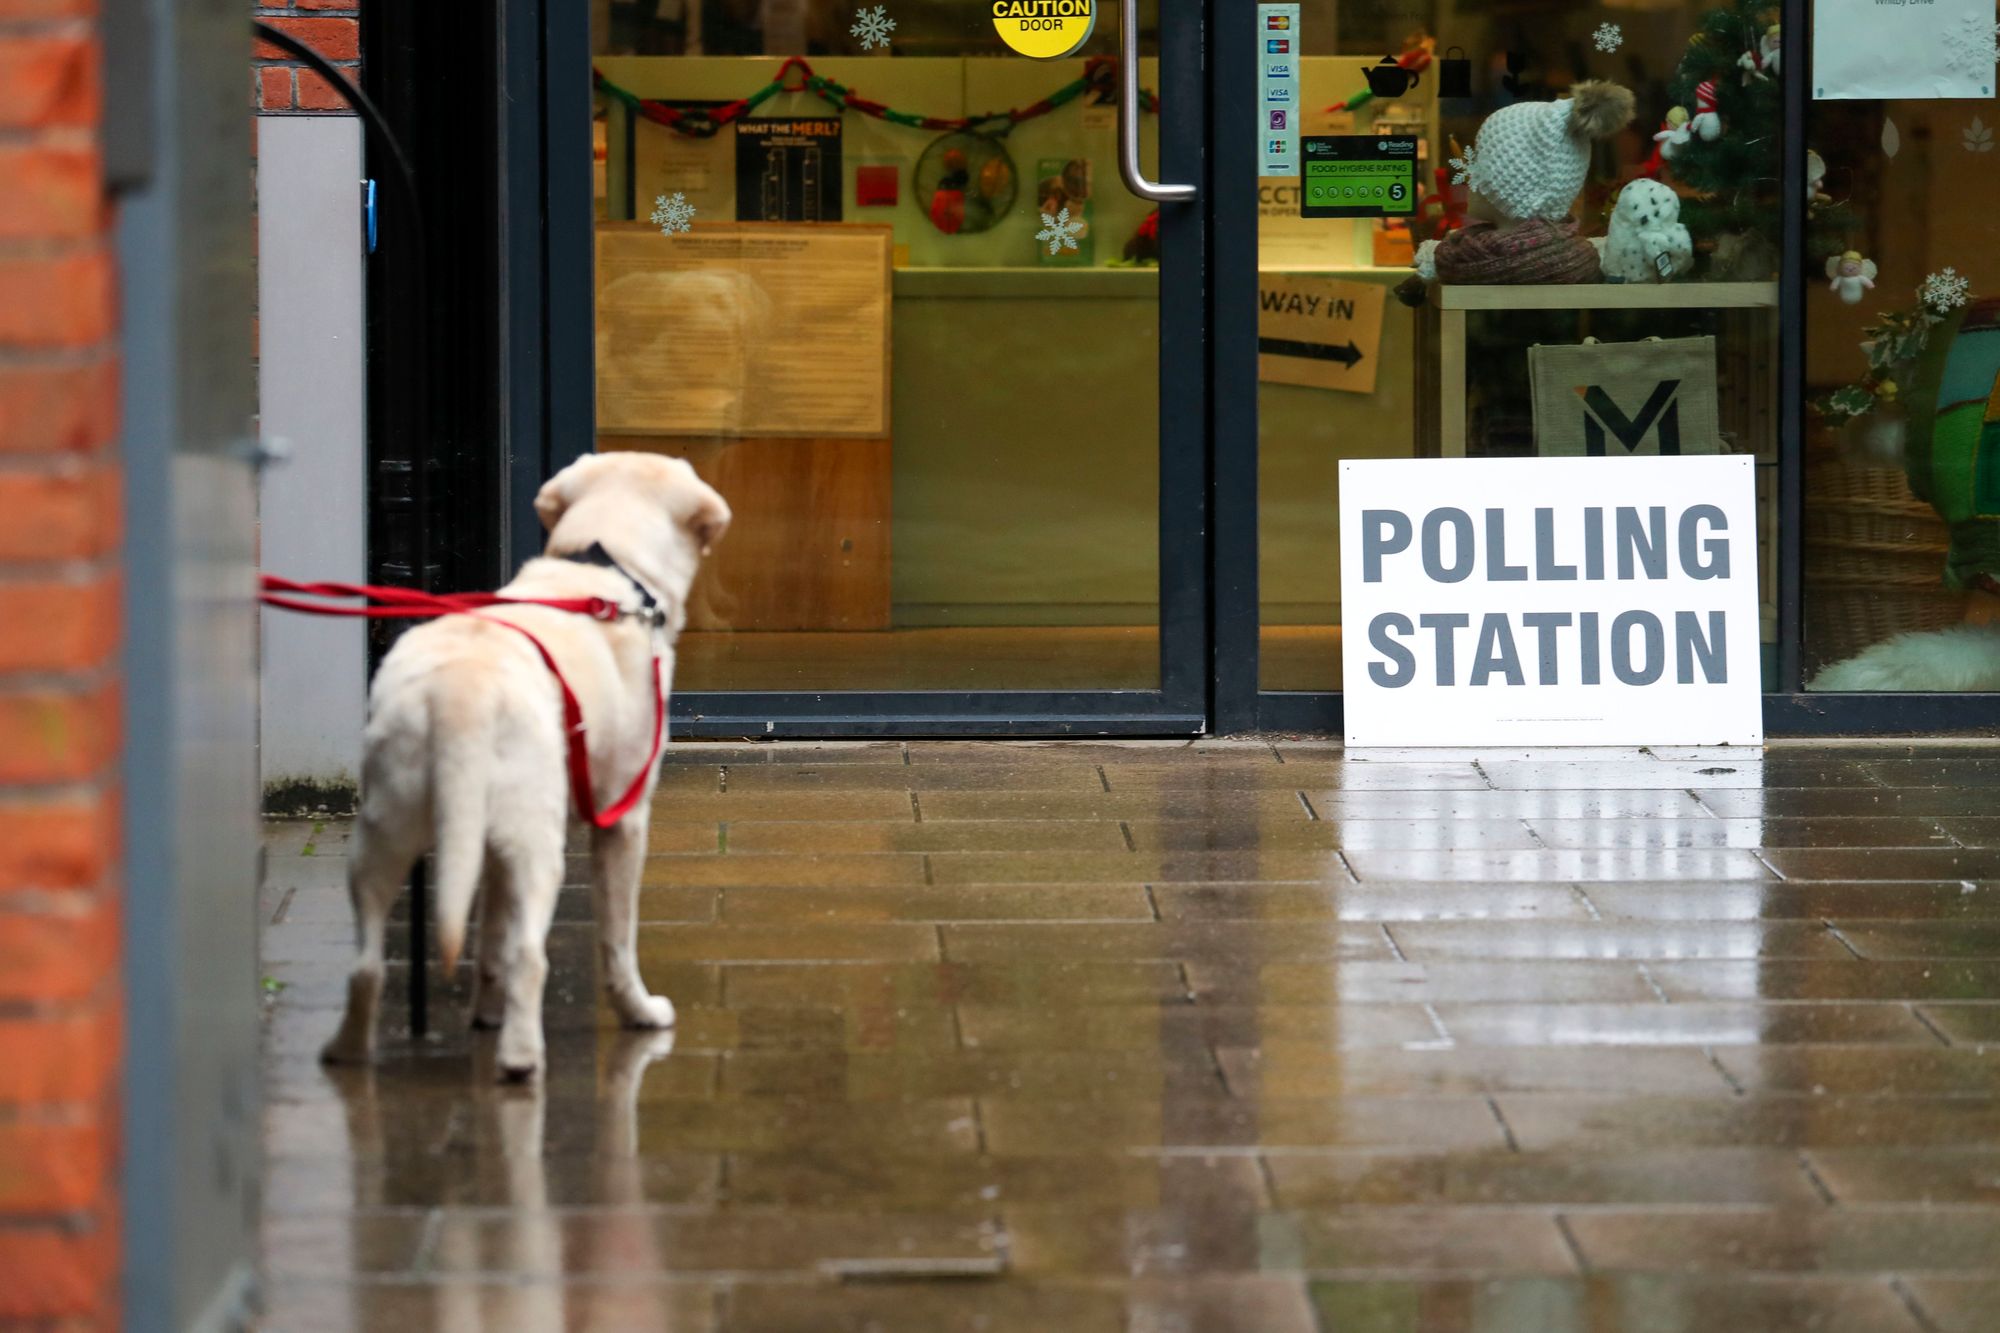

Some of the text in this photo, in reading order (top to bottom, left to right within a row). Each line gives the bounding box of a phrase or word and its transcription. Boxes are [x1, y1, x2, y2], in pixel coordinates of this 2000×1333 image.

[992, 0, 1090, 17] CAUTION
[1020, 19, 1063, 31] DOOR
[1271, 65, 1289, 73] VISA
[737, 121, 841, 136] WHAT THE MERL?
[1312, 164, 1408, 173] FOOD HYGIENE RATING
[1258, 185, 1301, 205] CCT
[1392, 185, 1402, 199] 5
[1260, 290, 1355, 321] WAY IN
[1362, 504, 1731, 584] POLLING
[1367, 609, 1728, 689] STATION
